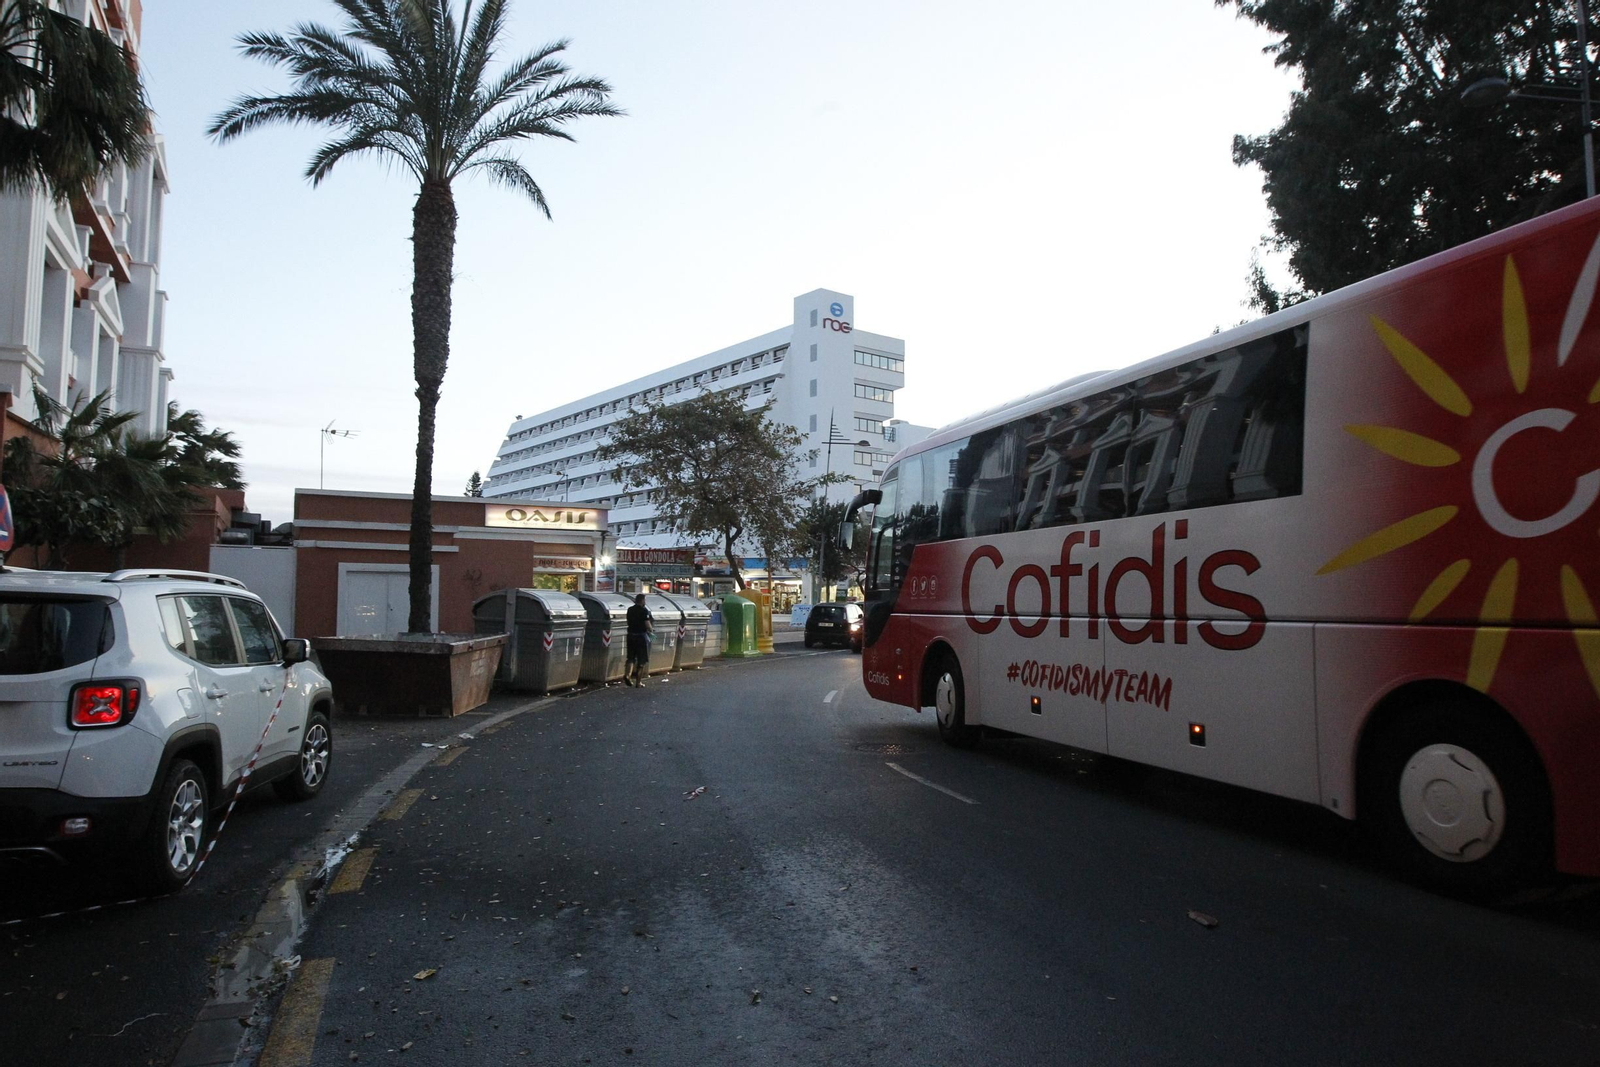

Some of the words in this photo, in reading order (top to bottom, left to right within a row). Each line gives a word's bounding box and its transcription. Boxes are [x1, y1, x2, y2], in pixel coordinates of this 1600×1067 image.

[505, 508, 590, 524] OASIS
[633, 551, 643, 562] LA
[644, 551, 675, 563] GONDOLA
[963, 519, 1268, 650] Cofidis
[867, 669, 890, 687] Cofidis
[1007, 658, 1173, 712] #COFIDISMYTEAM
